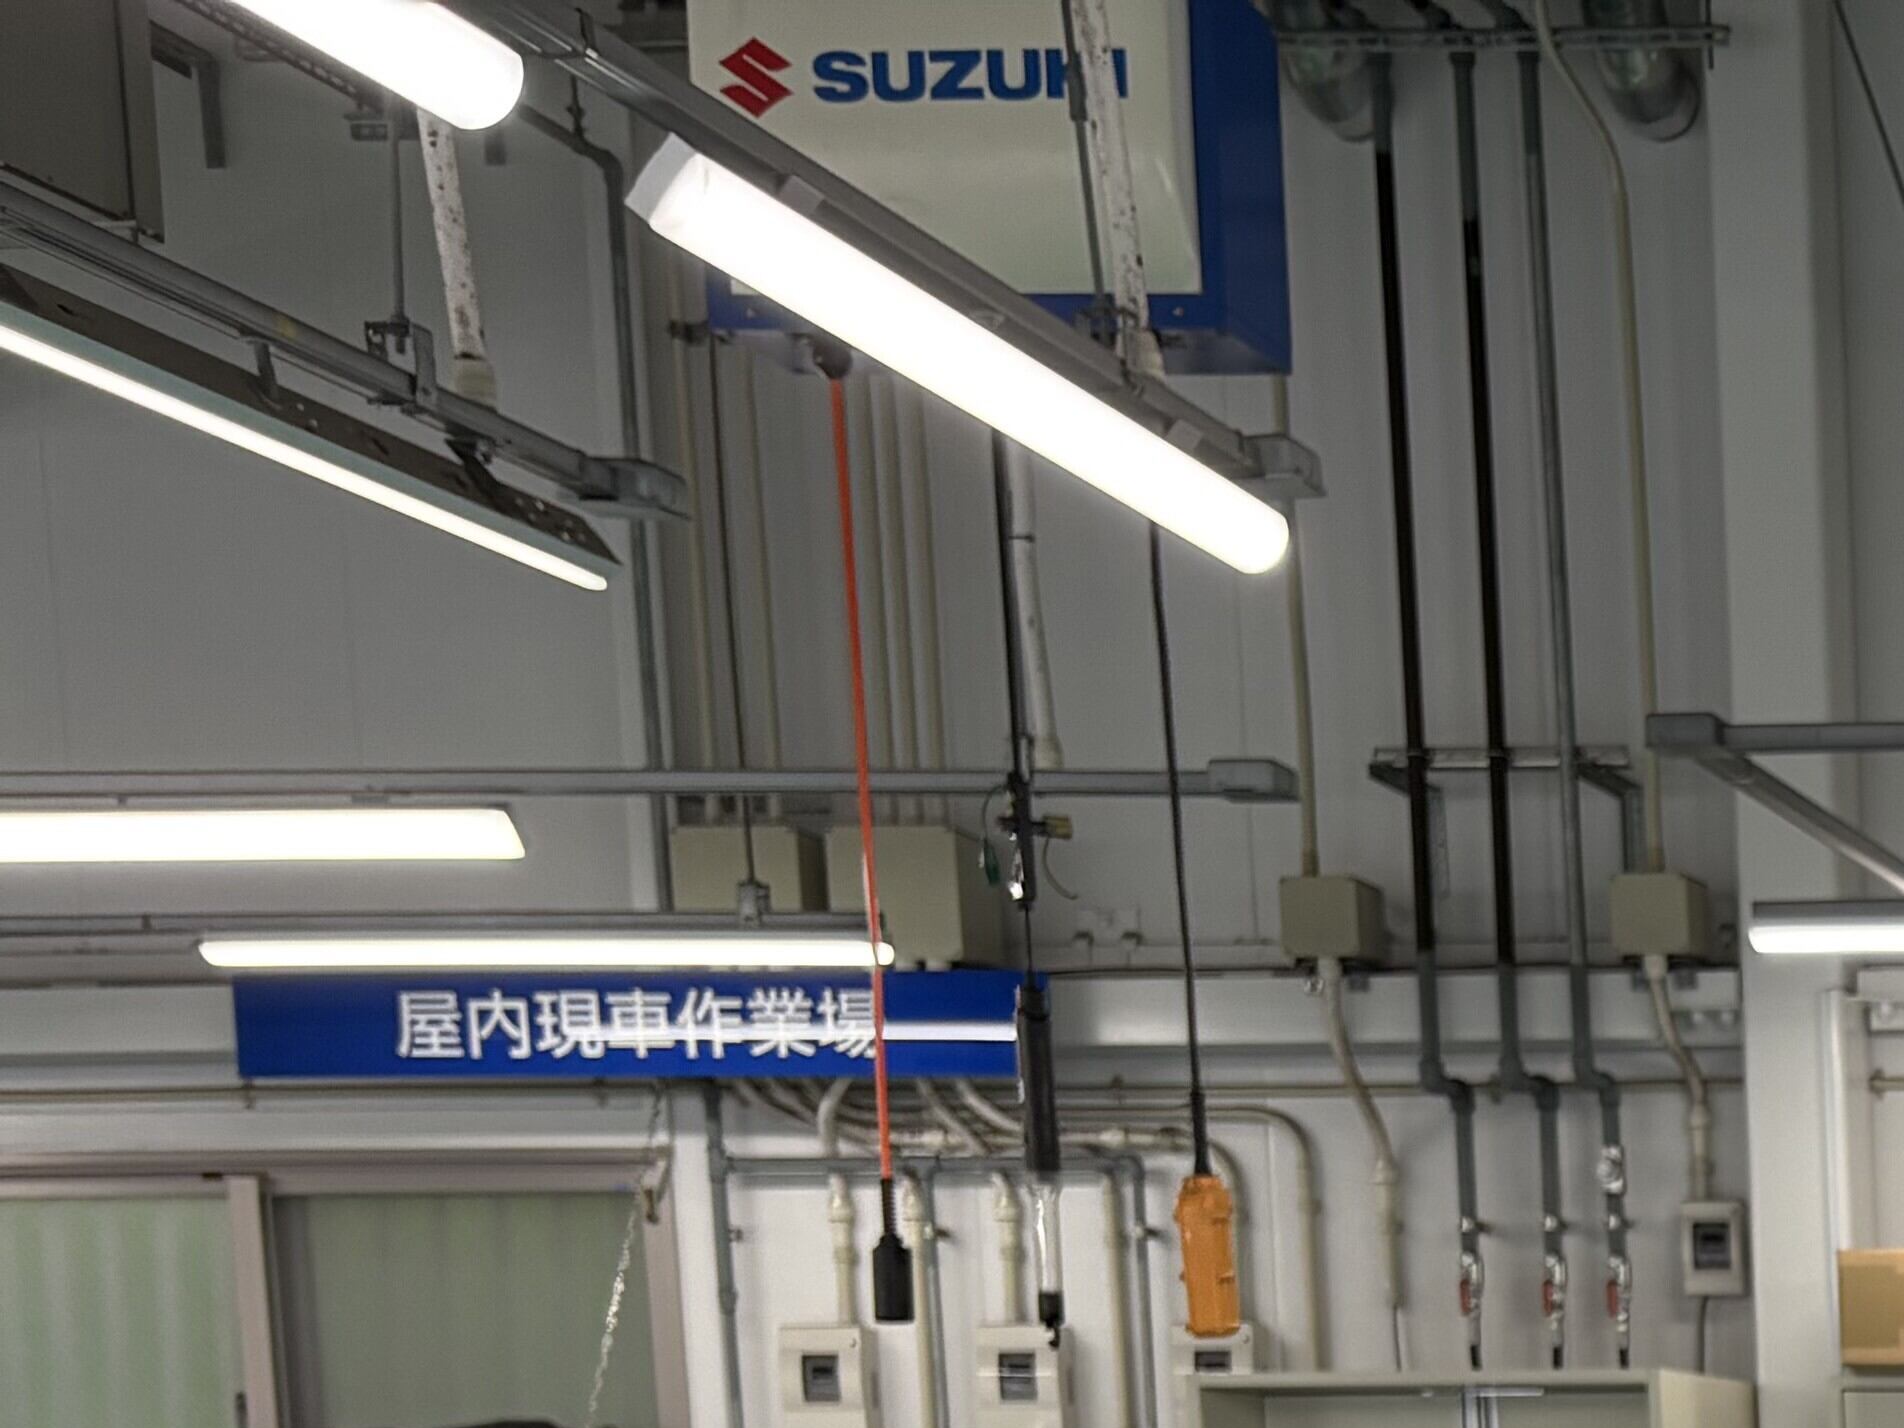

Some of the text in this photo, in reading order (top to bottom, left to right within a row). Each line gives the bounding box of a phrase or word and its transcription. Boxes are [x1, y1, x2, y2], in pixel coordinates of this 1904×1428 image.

[397, 988, 878, 1061] 屋内現車作業場
